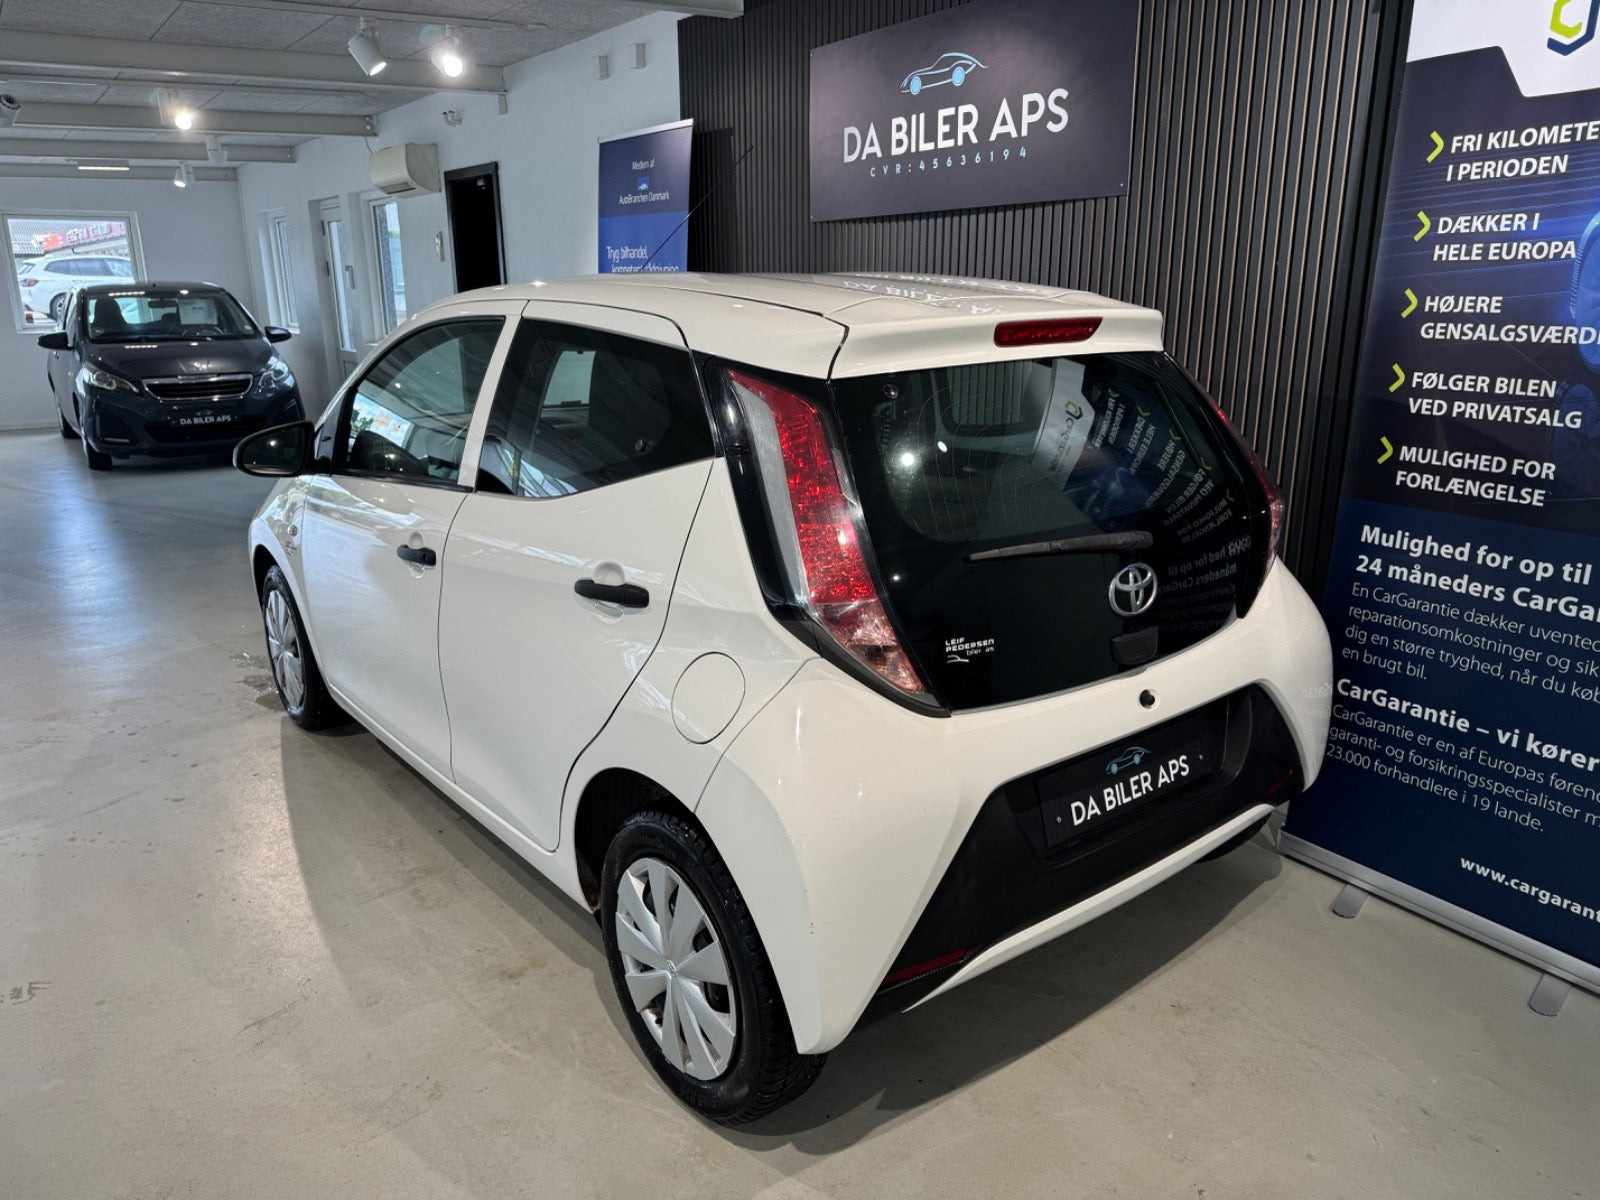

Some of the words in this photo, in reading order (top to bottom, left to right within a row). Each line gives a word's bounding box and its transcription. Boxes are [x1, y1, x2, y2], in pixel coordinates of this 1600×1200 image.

[843, 122, 882, 163] DA
[891, 103, 978, 156] BILER
[989, 88, 1069, 142] APS
[1451, 133, 1483, 154] FRI
[1487, 120, 1600, 150] KILOMETE
[870, 146, 1027, 177] CVR:45636194
[1446, 164, 1454, 181] I
[1457, 154, 1569, 181] PERIODEN
[1437, 214, 1526, 235] DÆKKER
[1531, 213, 1540, 231] I
[606, 246, 620, 263] Tryg
[1433, 244, 1483, 261] HELE
[1488, 241, 1577, 260] EUROPA
[1424, 295, 1503, 314] HØJERE
[1411, 371, 1491, 394] FØLGER
[1494, 377, 1557, 398] BILEN
[194, 416, 215, 424] BILER
[216, 414, 232, 422] APS
[1408, 397, 1448, 417] VED
[1451, 400, 1582, 429] PRIVATSALG
[1399, 445, 1507, 473] MULIGHED
[1511, 461, 1557, 481] FOR
[1395, 470, 1546, 507] FORLÆNGELSE
[1361, 524, 1471, 562] Mulighed
[1476, 544, 1514, 571] for
[1519, 559, 1555, 582] op
[1562, 562, 1592, 585] til
[1356, 555, 1383, 576] 24
[1387, 563, 1506, 602] måneders
[1352, 582, 1369, 599] En
[1372, 587, 1460, 620] CarGarantie
[1464, 608, 1526, 635] dækker
[945, 636, 965, 646] LEIF
[1348, 606, 1543, 663] reparationsomkostninger
[1546, 654, 1571, 684] og
[1575, 660, 1600, 678] sik
[1342, 647, 1360, 661] en
[1363, 649, 1402, 674] brugt
[1406, 660, 1427, 680] bil.
[1345, 625, 1368, 645] dig
[1371, 633, 1390, 648] en
[1393, 639, 1436, 660] større
[1439, 648, 1505, 681] tryghed,
[1510, 668, 1539, 687] når
[1542, 675, 1566, 694] du
[1337, 678, 1470, 733] CarGarantie
[1496, 728, 1520, 748] vi
[1525, 732, 1600, 772] kører
[1332, 704, 1414, 742] CarGarantie
[1417, 733, 1434, 748] er
[1436, 740, 1456, 756] en
[1459, 746, 1477, 761] af
[1478, 750, 1545, 784] Europas
[1070, 795, 1101, 827] DA
[1103, 771, 1153, 812] BILER
[1157, 754, 1190, 789] APS
[1326, 743, 1371, 769] 23.000
[1373, 758, 1458, 801] forhandlere
[1461, 791, 1468, 804] i
[1472, 794, 1491, 812] 19
[1494, 800, 1544, 832] lande.
[1329, 727, 1382, 751] garanti-
[1385, 745, 1405, 763] og
[1408, 749, 1581, 820] forsikringsspecialister
